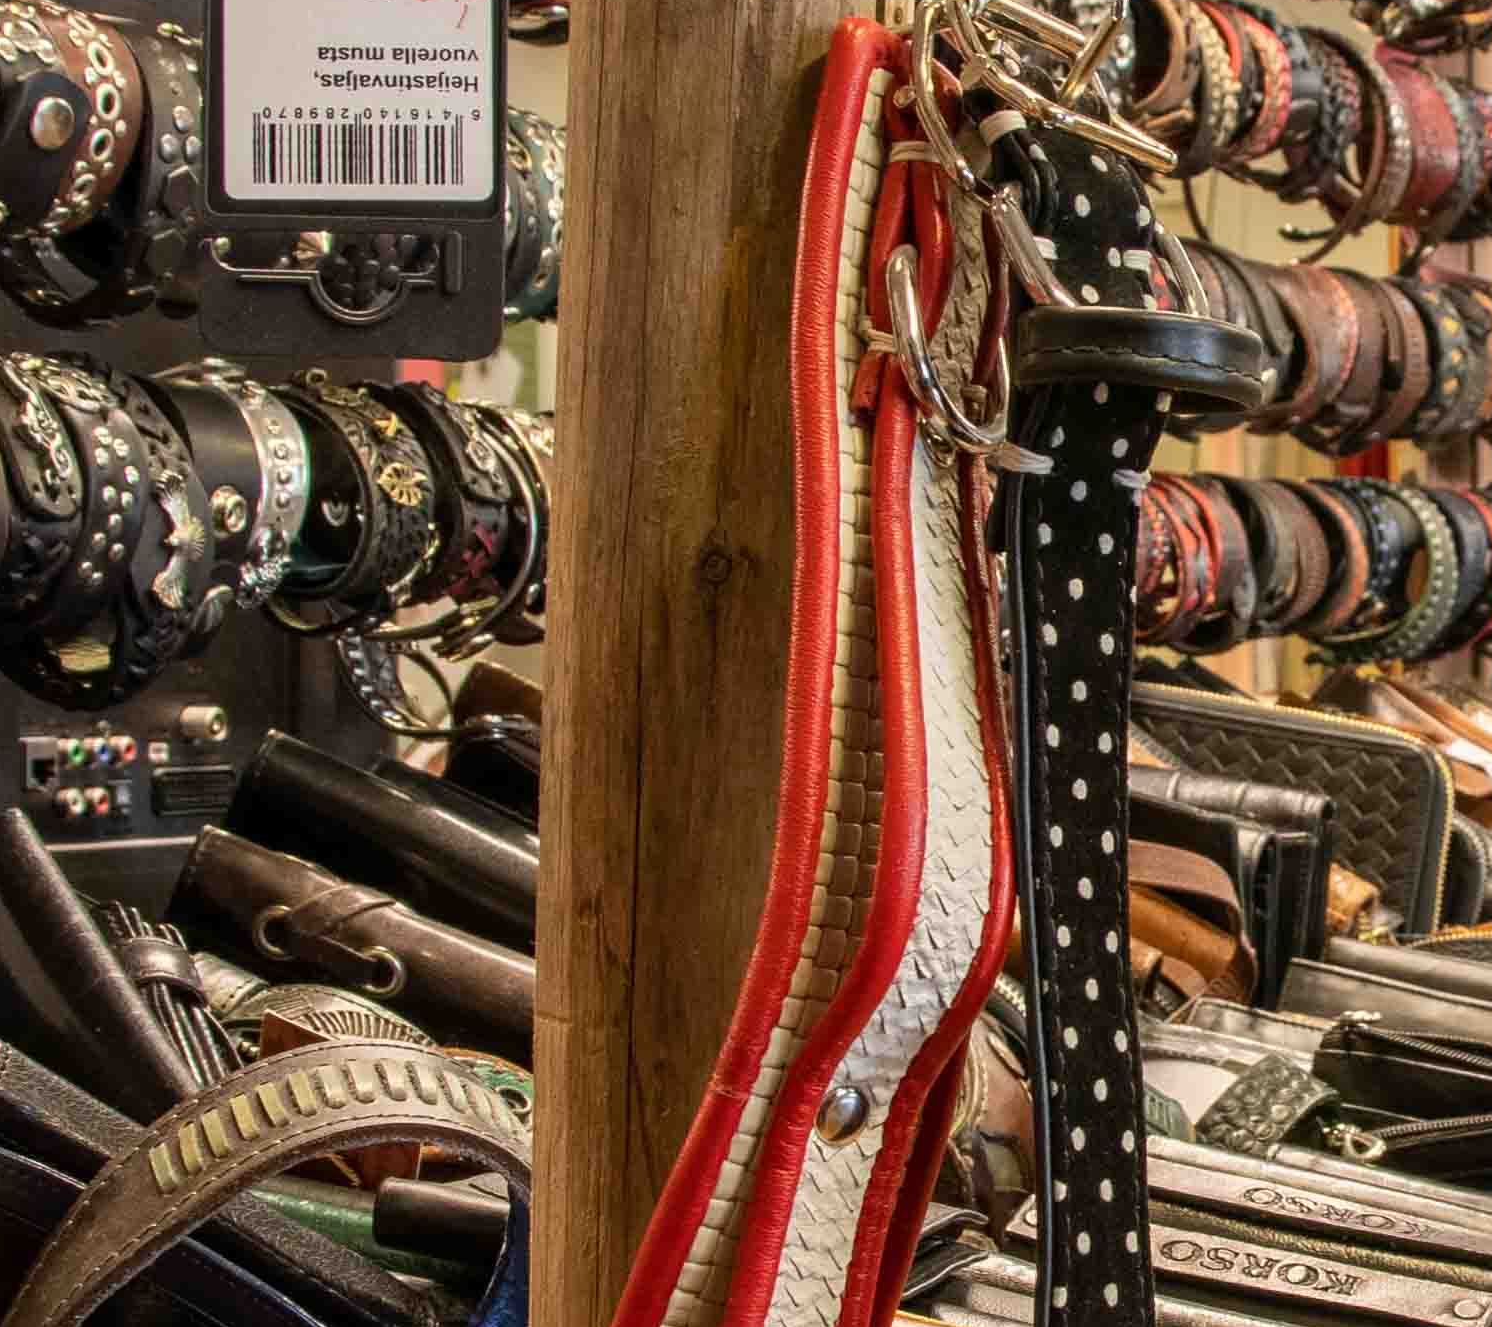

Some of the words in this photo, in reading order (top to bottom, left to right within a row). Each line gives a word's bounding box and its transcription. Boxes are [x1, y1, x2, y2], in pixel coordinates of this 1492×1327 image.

[317, 45, 385, 61] musta
[391, 46, 479, 62] vuorella
[313, 71, 479, 93] Heijastinvaljas,
[1243, 1186, 1440, 1238] KORSO
[1160, 1239, 1362, 1296] KORSO
